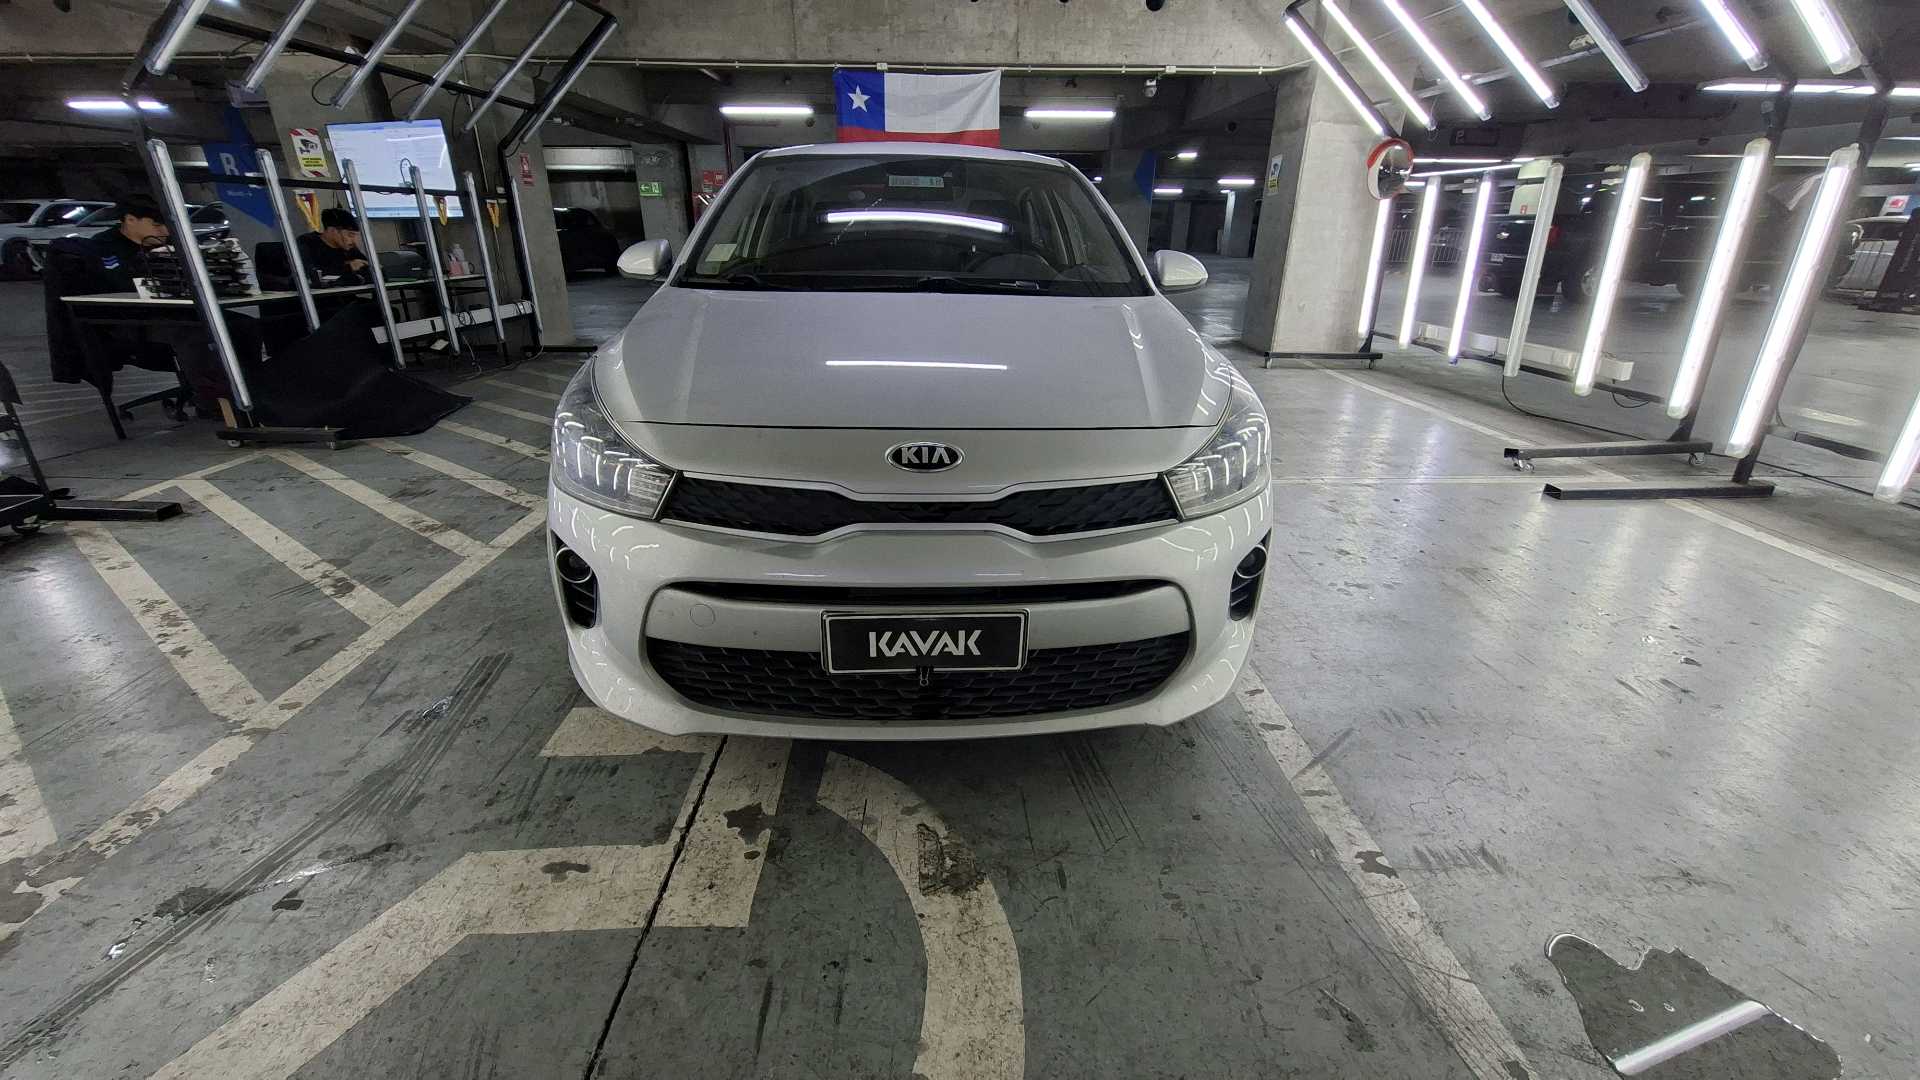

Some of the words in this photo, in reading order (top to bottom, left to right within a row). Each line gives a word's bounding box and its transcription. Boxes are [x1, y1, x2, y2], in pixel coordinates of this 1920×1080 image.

[219, 152, 240, 176] R
[901, 446, 951, 464] KIA
[868, 630, 983, 657] KAVAK
